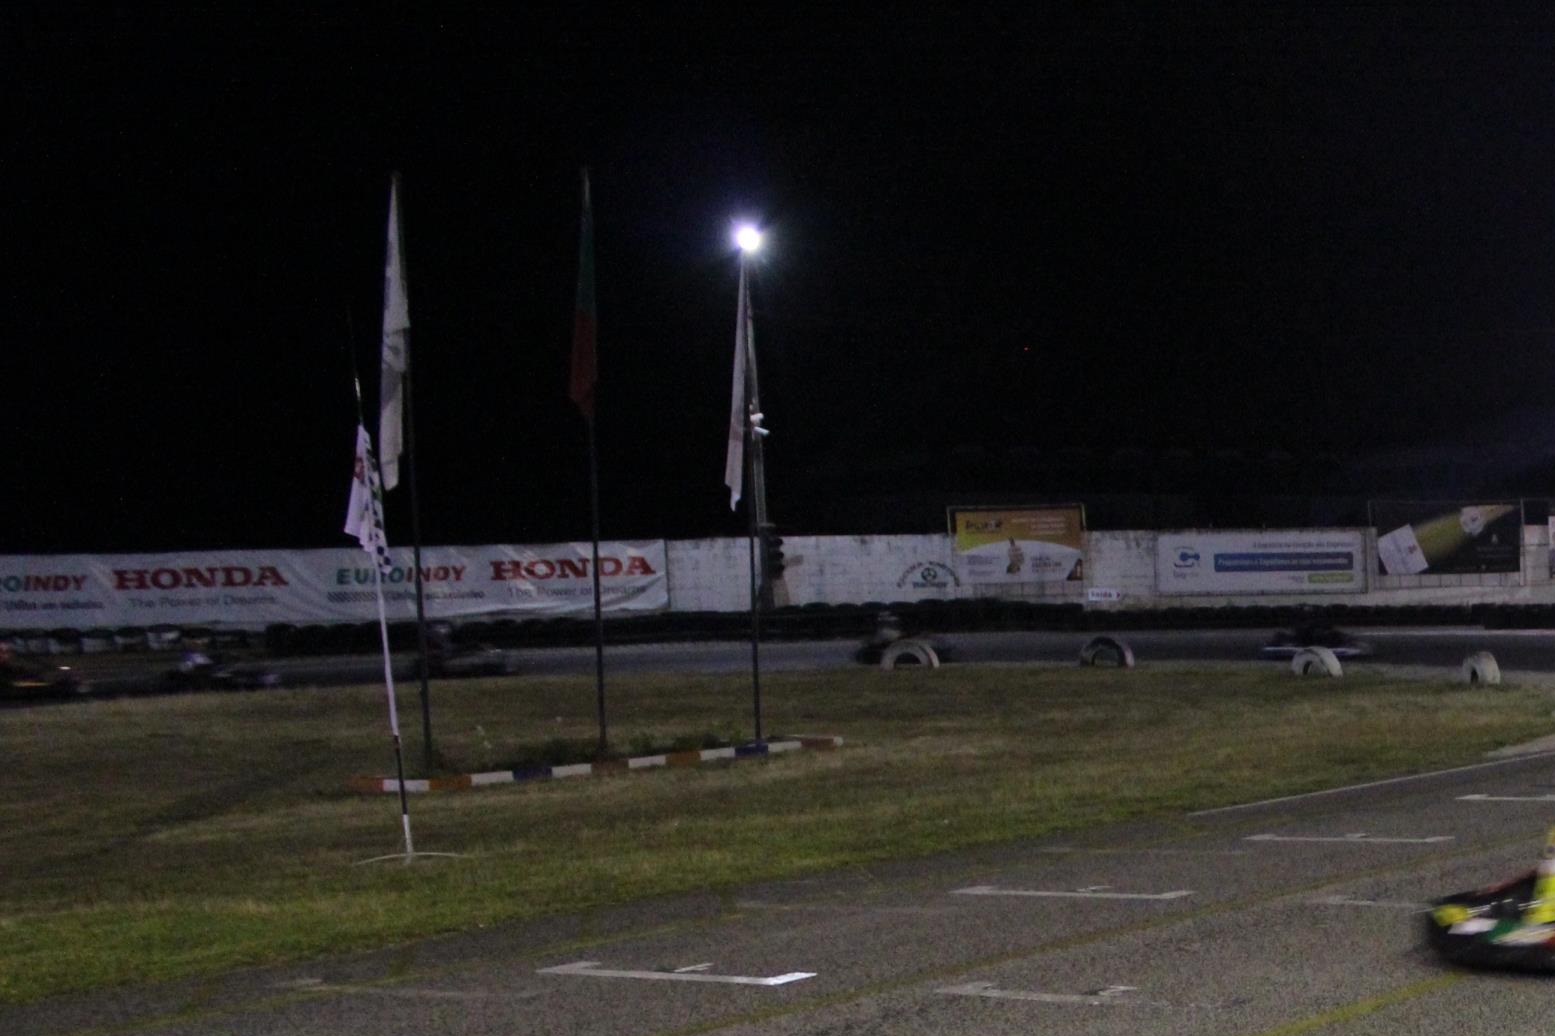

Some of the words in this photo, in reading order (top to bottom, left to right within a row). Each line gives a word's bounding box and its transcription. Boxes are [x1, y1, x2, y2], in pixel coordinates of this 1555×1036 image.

[113, 566, 288, 590] HONDA
[490, 555, 656, 581] HONDA
[0, 575, 88, 592] OINDY
